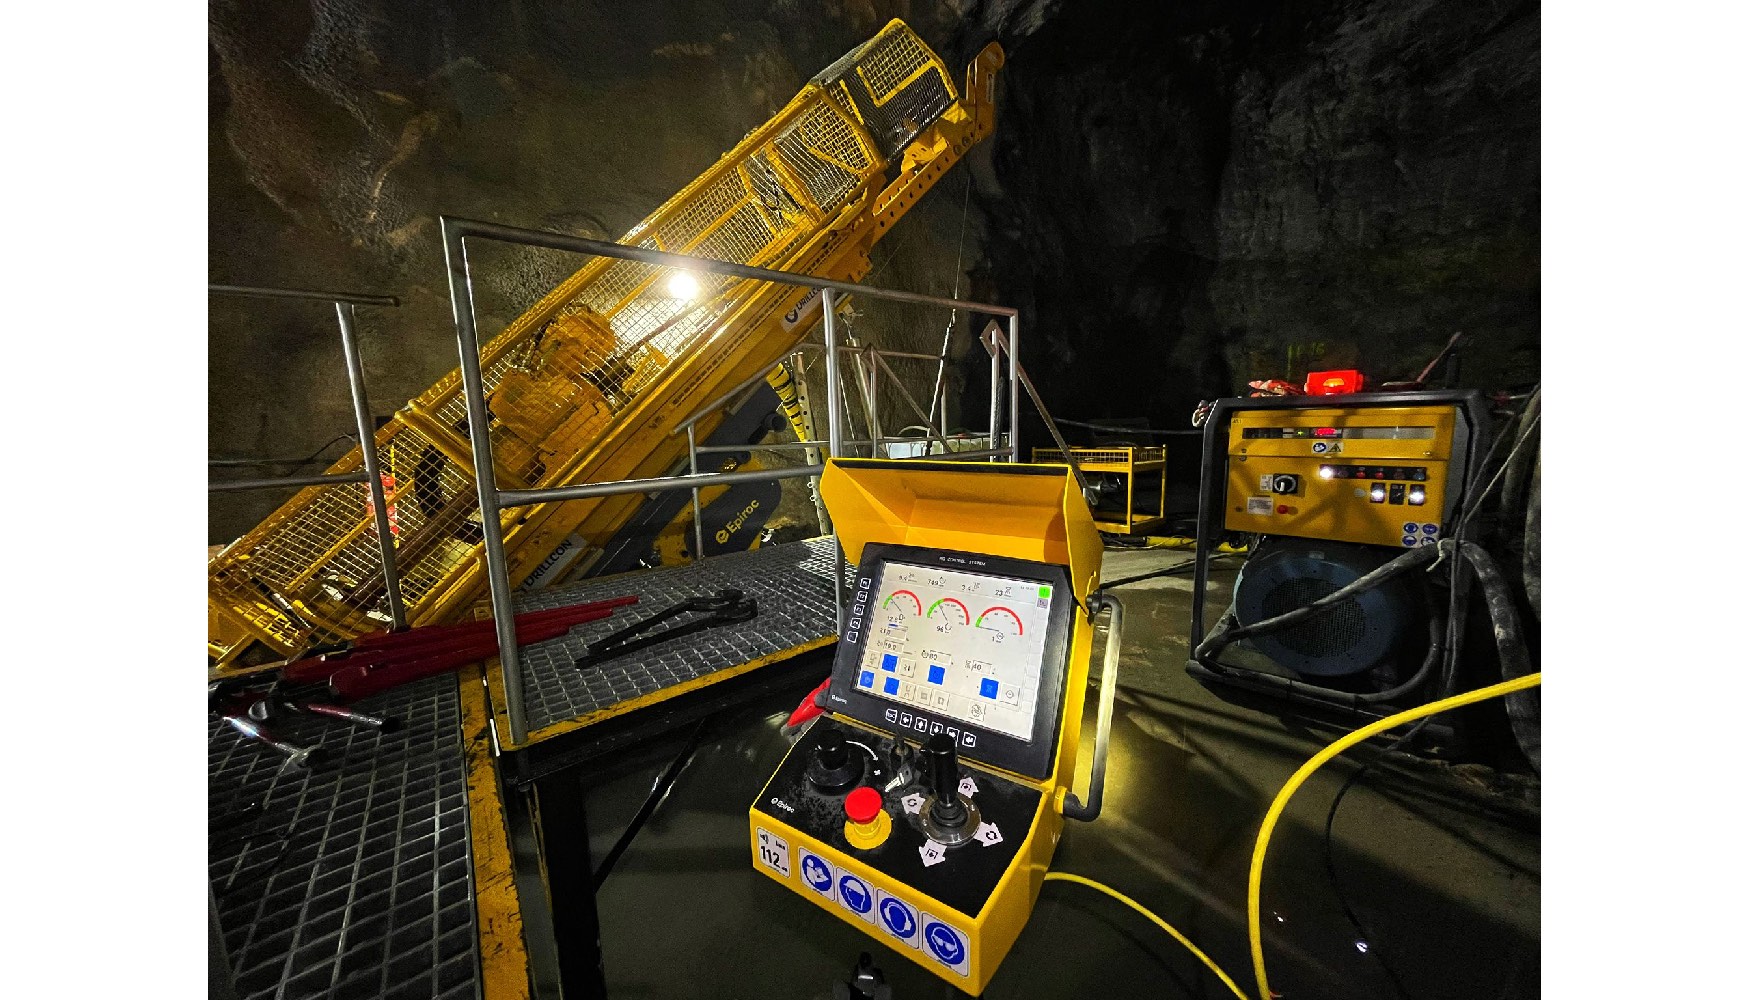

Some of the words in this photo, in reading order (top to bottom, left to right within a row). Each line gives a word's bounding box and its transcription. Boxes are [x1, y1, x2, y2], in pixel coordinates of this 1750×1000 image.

[796, 285, 822, 311] DRILLC
[726, 500, 760, 533] Epiroc
[523, 539, 573, 587] DRILLCON
[760, 845, 781, 869] 112
